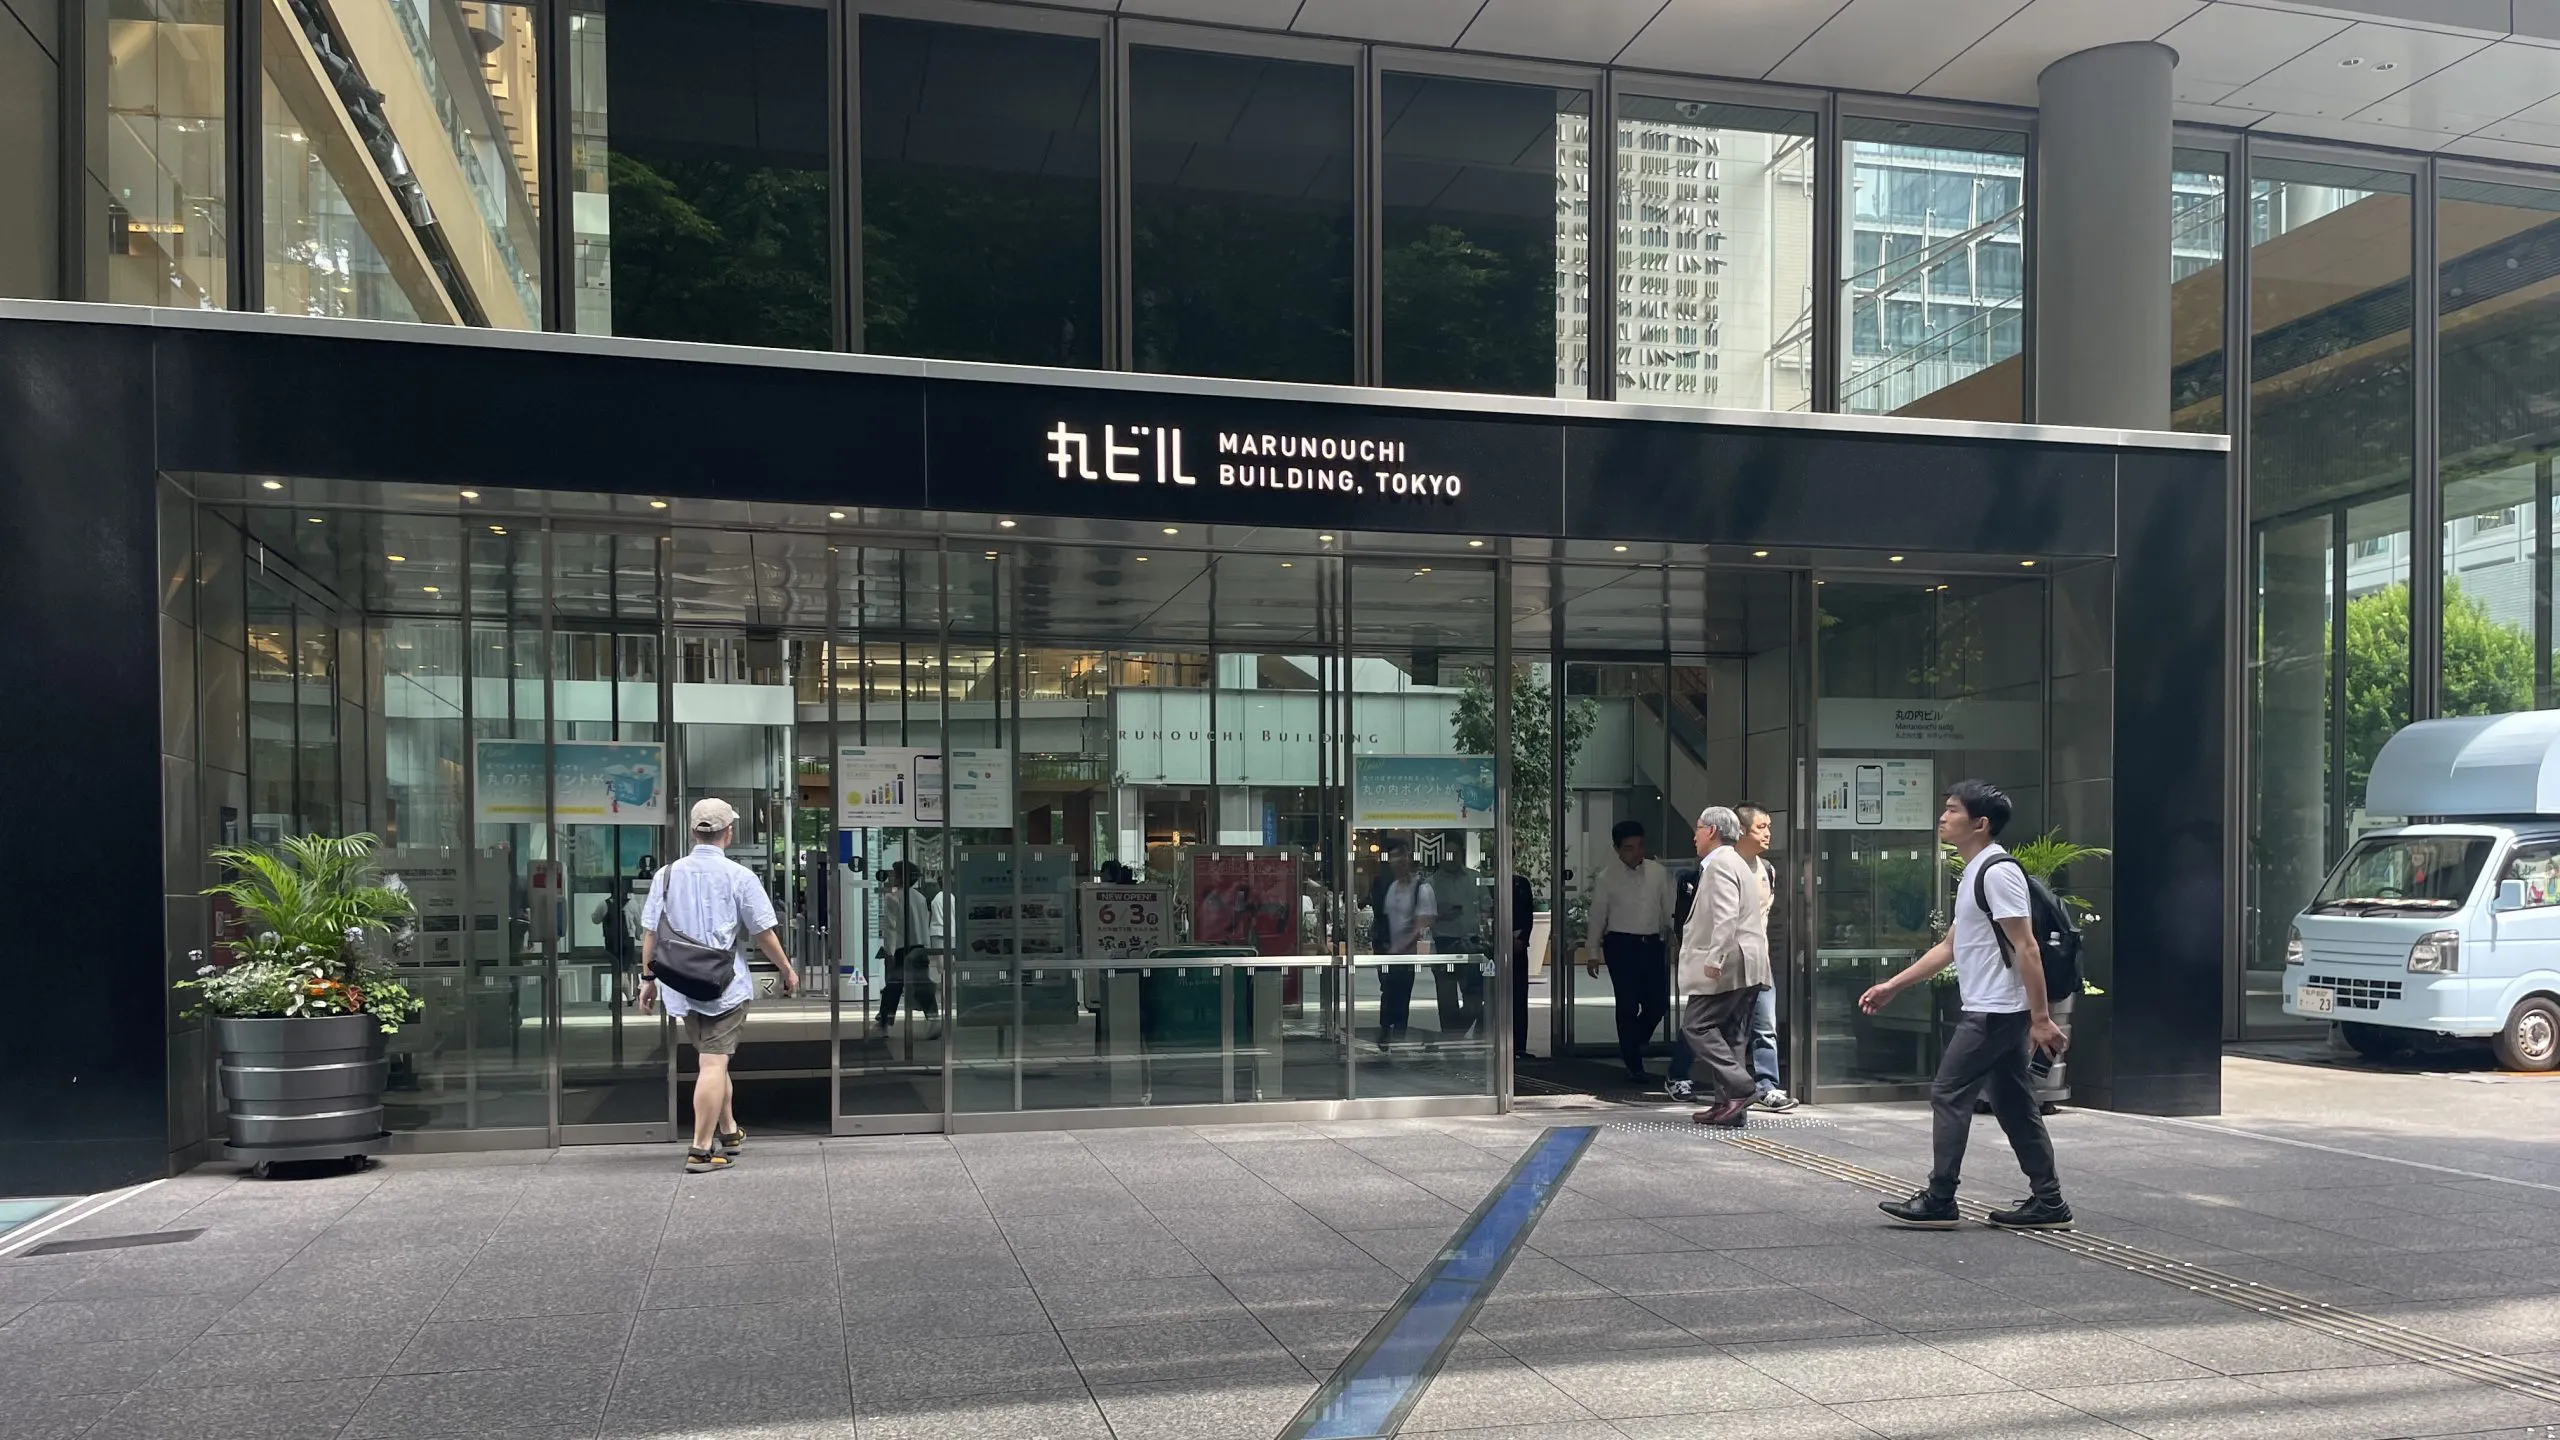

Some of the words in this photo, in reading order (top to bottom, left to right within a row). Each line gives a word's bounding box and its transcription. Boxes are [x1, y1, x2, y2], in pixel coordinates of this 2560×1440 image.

[1047, 421, 1196, 485] 丸ビル
[1219, 431, 1405, 462] MARUNOUCHI
[1219, 464, 1363, 494] BUILDING,
[1375, 472, 1462, 497] TOKYO
[1895, 710, 1943, 721] 丸の内ビル
[1362, 783, 1456, 796] 丸の内ポイントが
